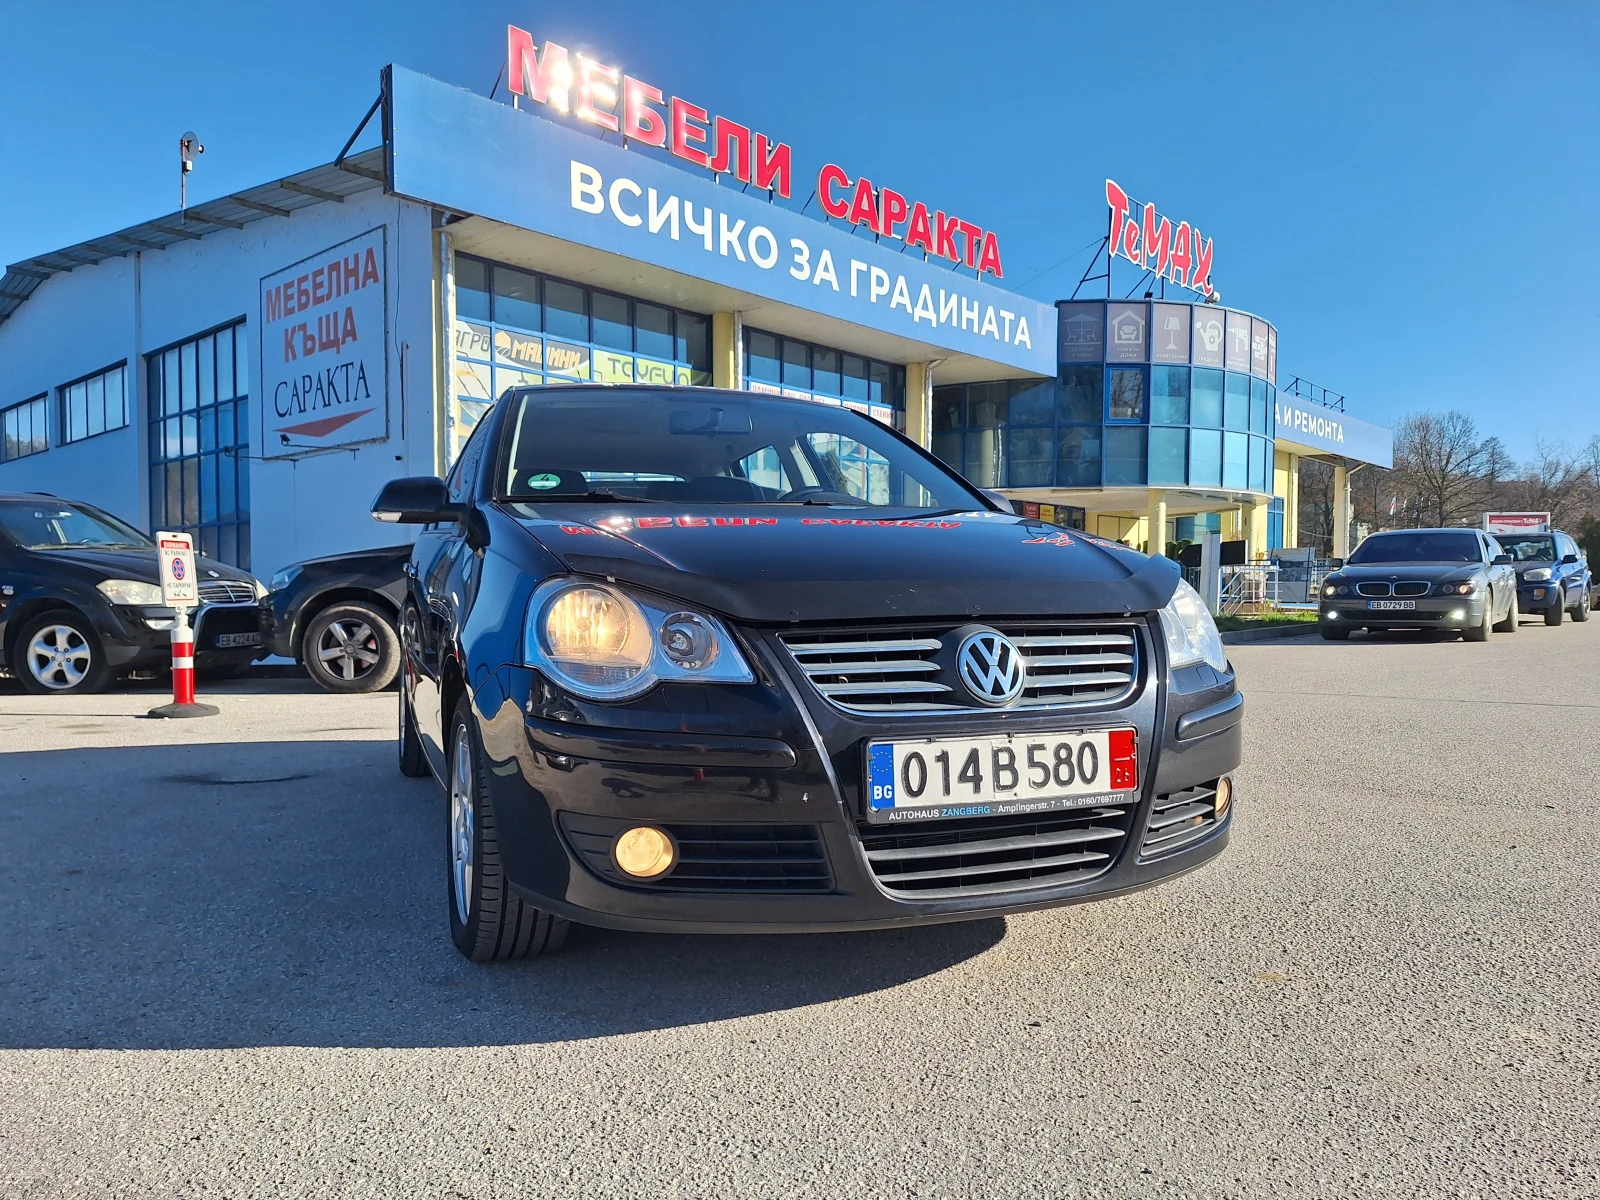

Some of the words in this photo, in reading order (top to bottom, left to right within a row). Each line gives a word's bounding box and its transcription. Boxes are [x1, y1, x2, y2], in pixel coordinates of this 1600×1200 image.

[507, 24, 791, 199] МЕБЕЛИ
[817, 163, 1003, 279] САРАКТА
[569, 160, 779, 270] ВСИЧКО
[789, 239, 840, 292] ЗА
[849, 258, 1032, 350] ГРАДИНАТА
[265, 247, 380, 324] МЕБЕЛНА
[283, 306, 359, 363] КЪЩА
[511, 340, 581, 369] МАШИНИ
[274, 359, 371, 419] САРАКТА
[1284, 405, 1292, 427] И
[1294, 409, 1344, 444] РЕМОНТА
[873, 784, 893, 800] BG
[889, 808, 940, 821] AUTOHAUS
[941, 805, 991, 817] ZANGBERG
[998, 801, 1050, 813] Ampfingerstr.
[1050, 800, 1056, 809] 7
[1062, 797, 1077, 808] Tel.:
[1078, 793, 1125, 806] 0160/7697777
